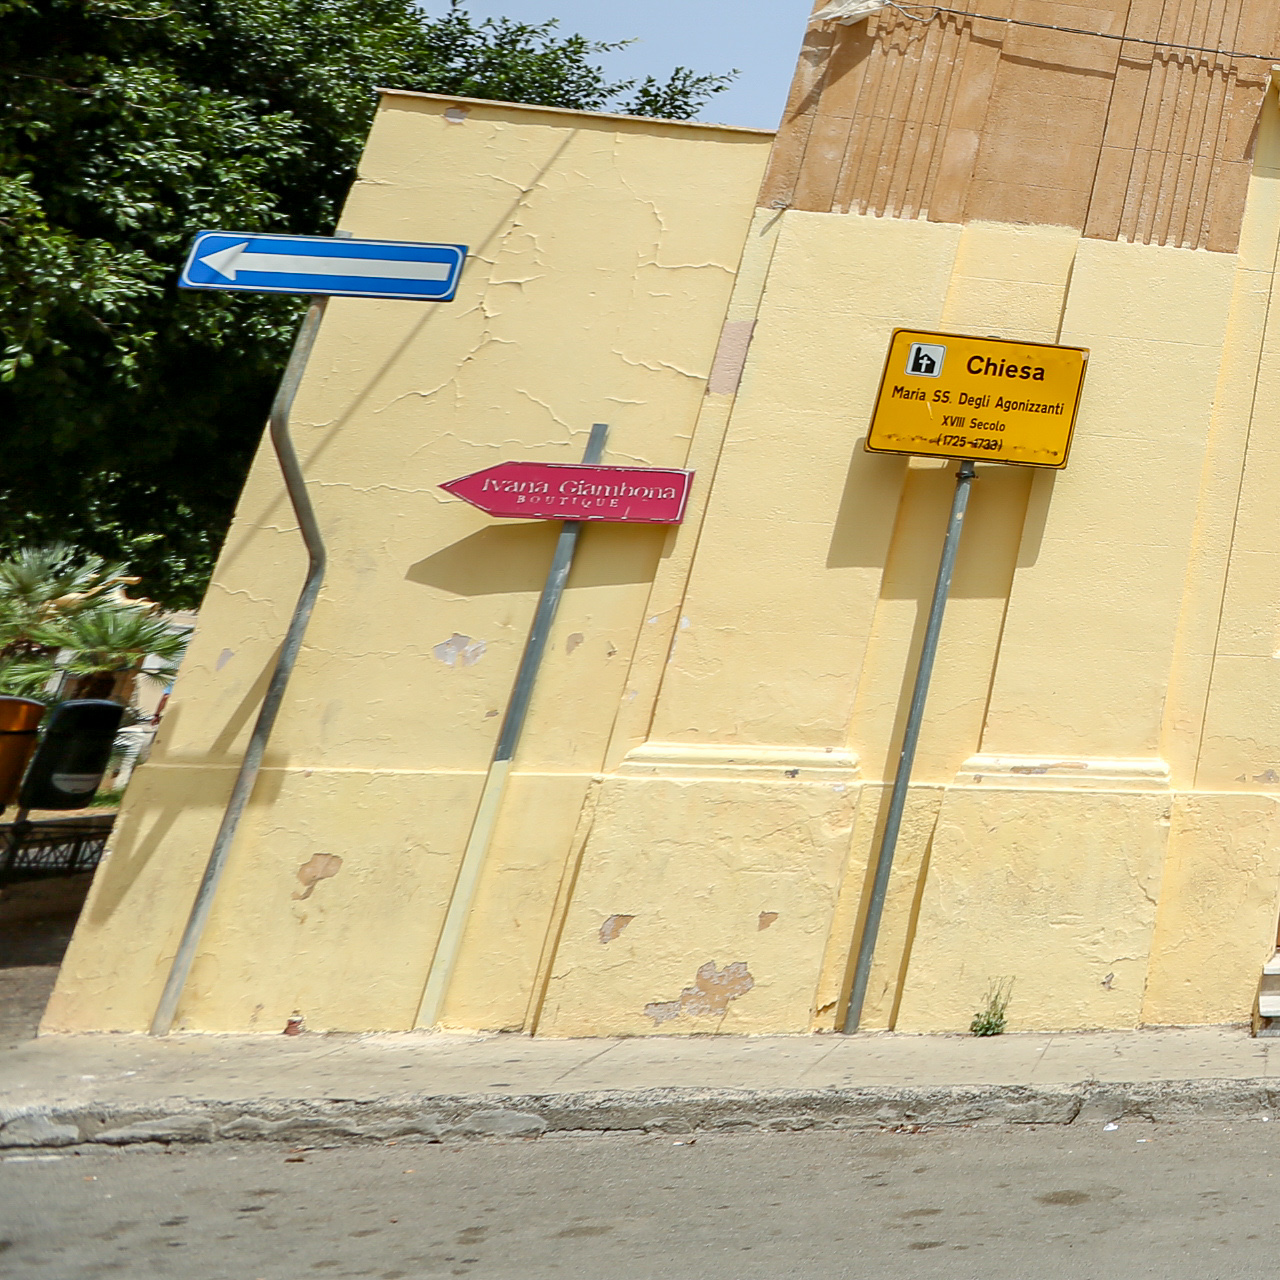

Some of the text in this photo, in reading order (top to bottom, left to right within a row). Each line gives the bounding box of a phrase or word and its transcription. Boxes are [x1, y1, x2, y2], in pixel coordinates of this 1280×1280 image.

[966, 354, 1046, 382] Chiesa
[891, 384, 1065, 416] Maria SS. Degli Agonizzanti
[941, 414, 1006, 432] XVIII Secolo
[481, 477, 549, 494] Ivana
[516, 494, 620, 508] BOUTIQUE
